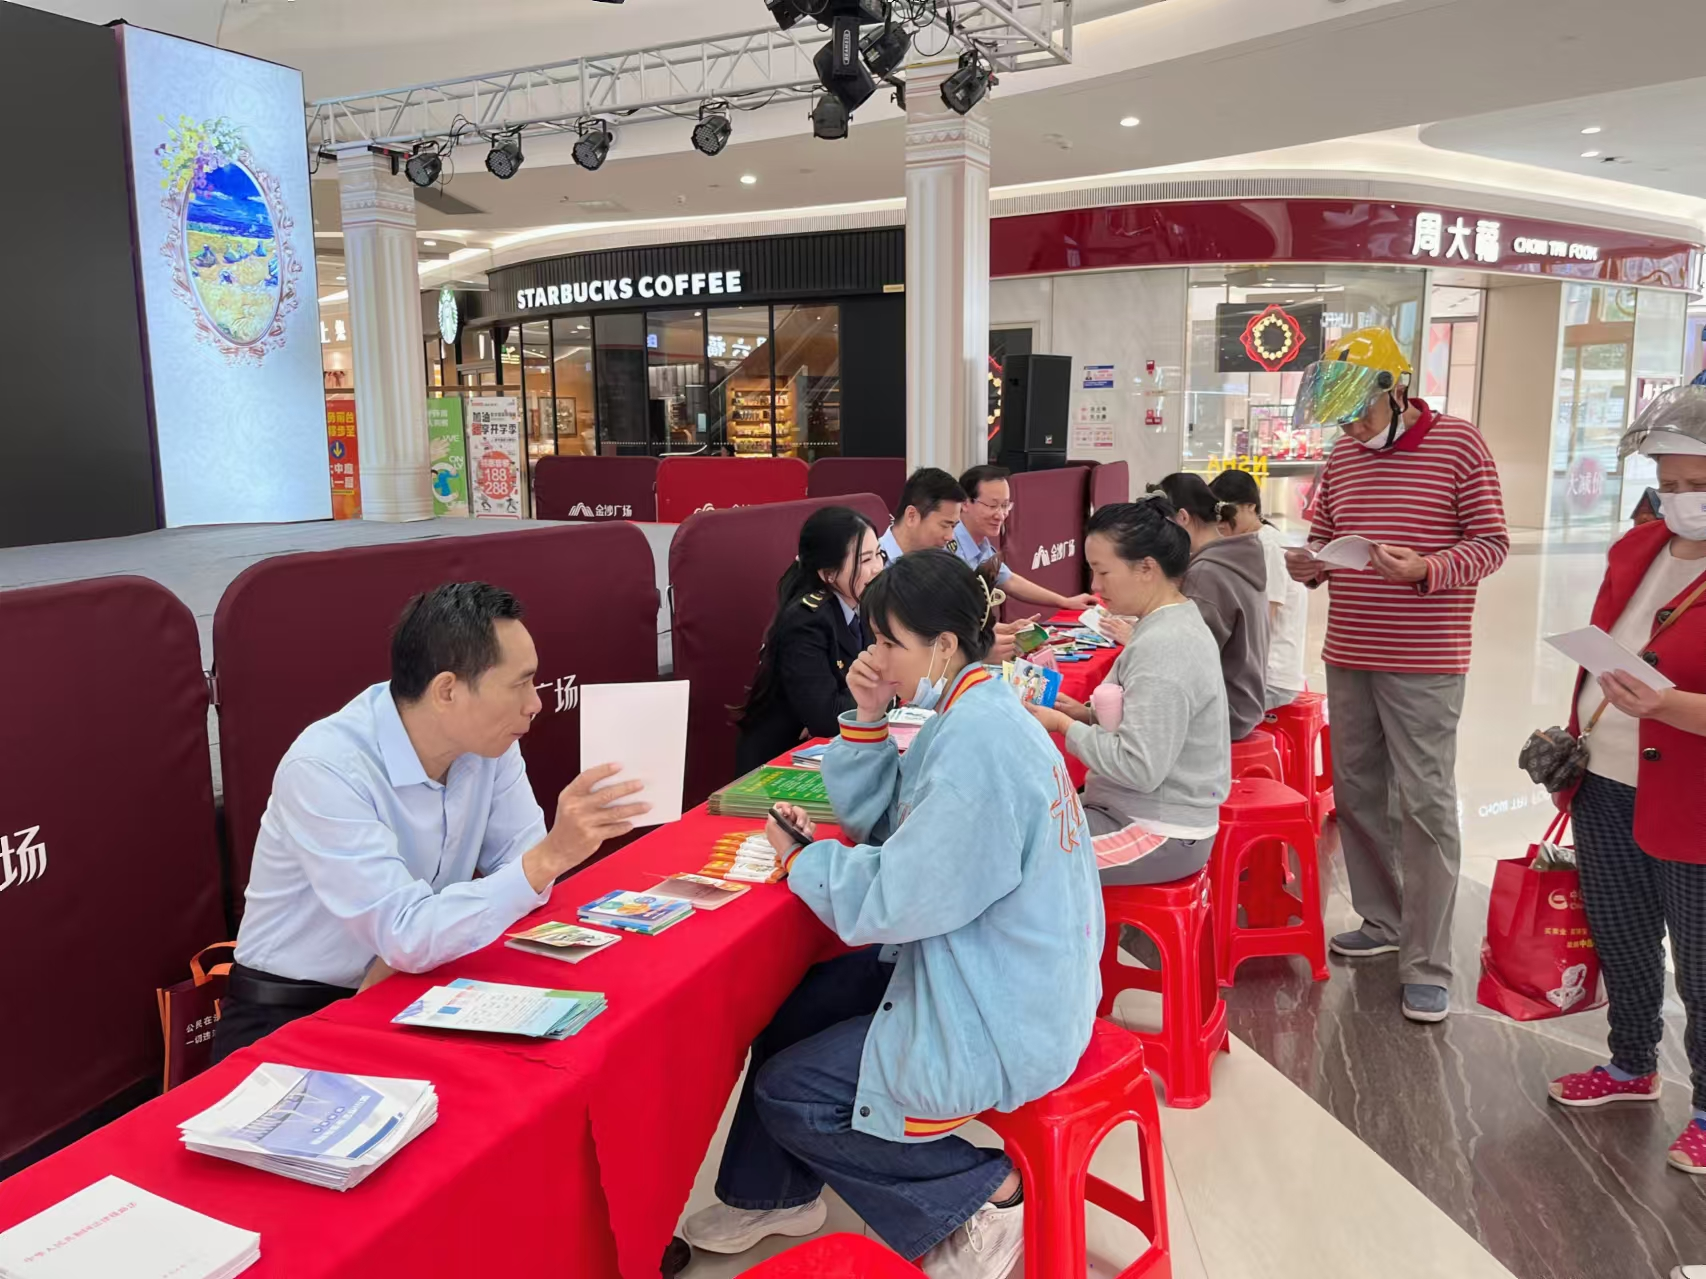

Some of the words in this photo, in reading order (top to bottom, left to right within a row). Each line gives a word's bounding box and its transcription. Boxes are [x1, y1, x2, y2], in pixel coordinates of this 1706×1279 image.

[1411, 211, 1500, 263] 周大福
[516, 277, 633, 310] STARBUCKS
[637, 270, 742, 297] COFFEE
[484, 467, 507, 481] 188
[484, 481, 509, 495] 288
[595, 503, 633, 517] 金沙广场
[0, 825, 48, 892] 场
